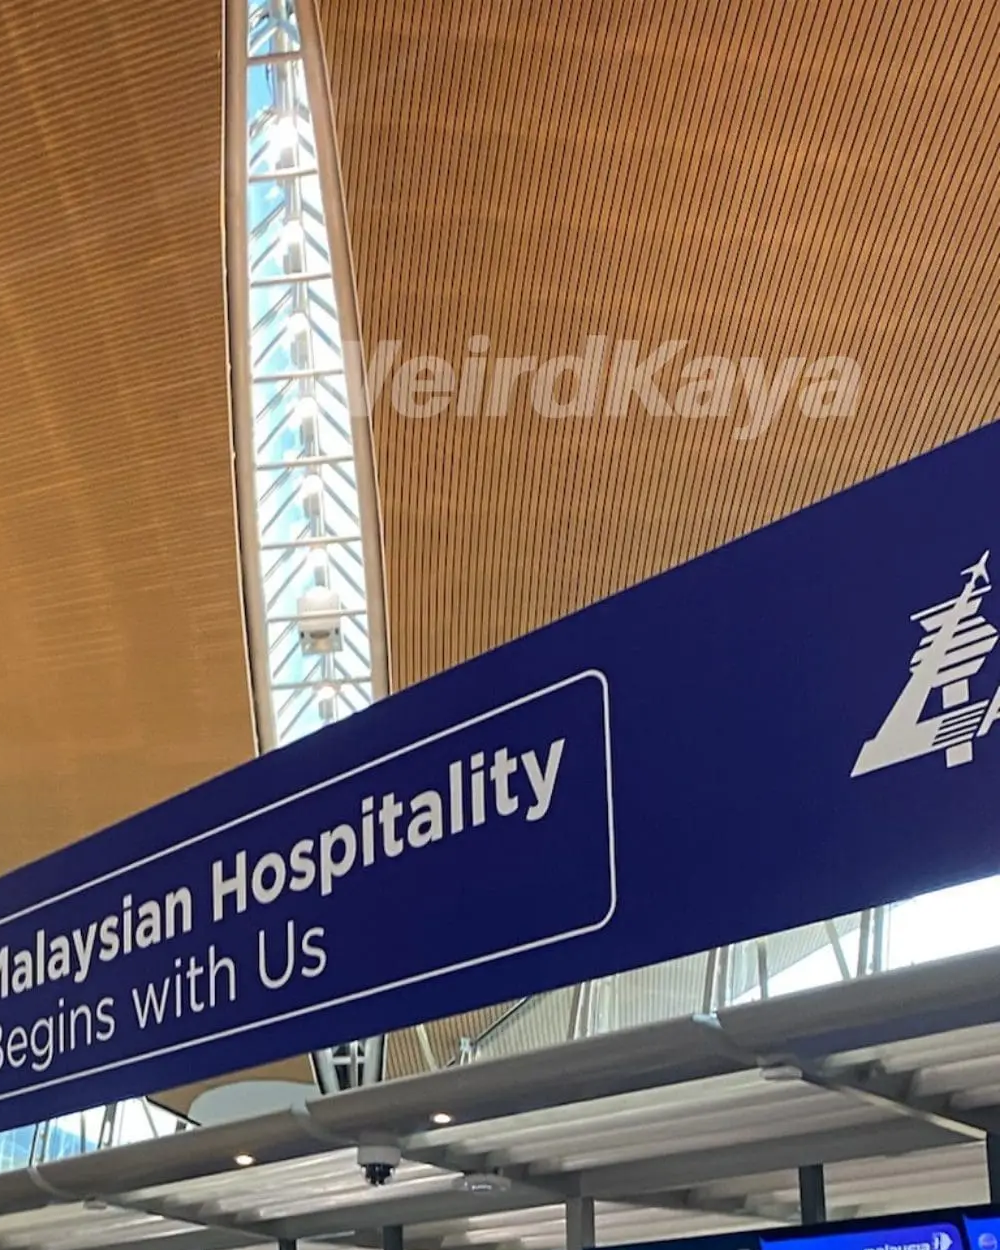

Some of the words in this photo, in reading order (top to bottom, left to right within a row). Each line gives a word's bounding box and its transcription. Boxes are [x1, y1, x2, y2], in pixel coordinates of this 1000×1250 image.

[212, 738, 566, 923] Hospitality
[132, 945, 237, 1029] with
[257, 920, 327, 989] Us
